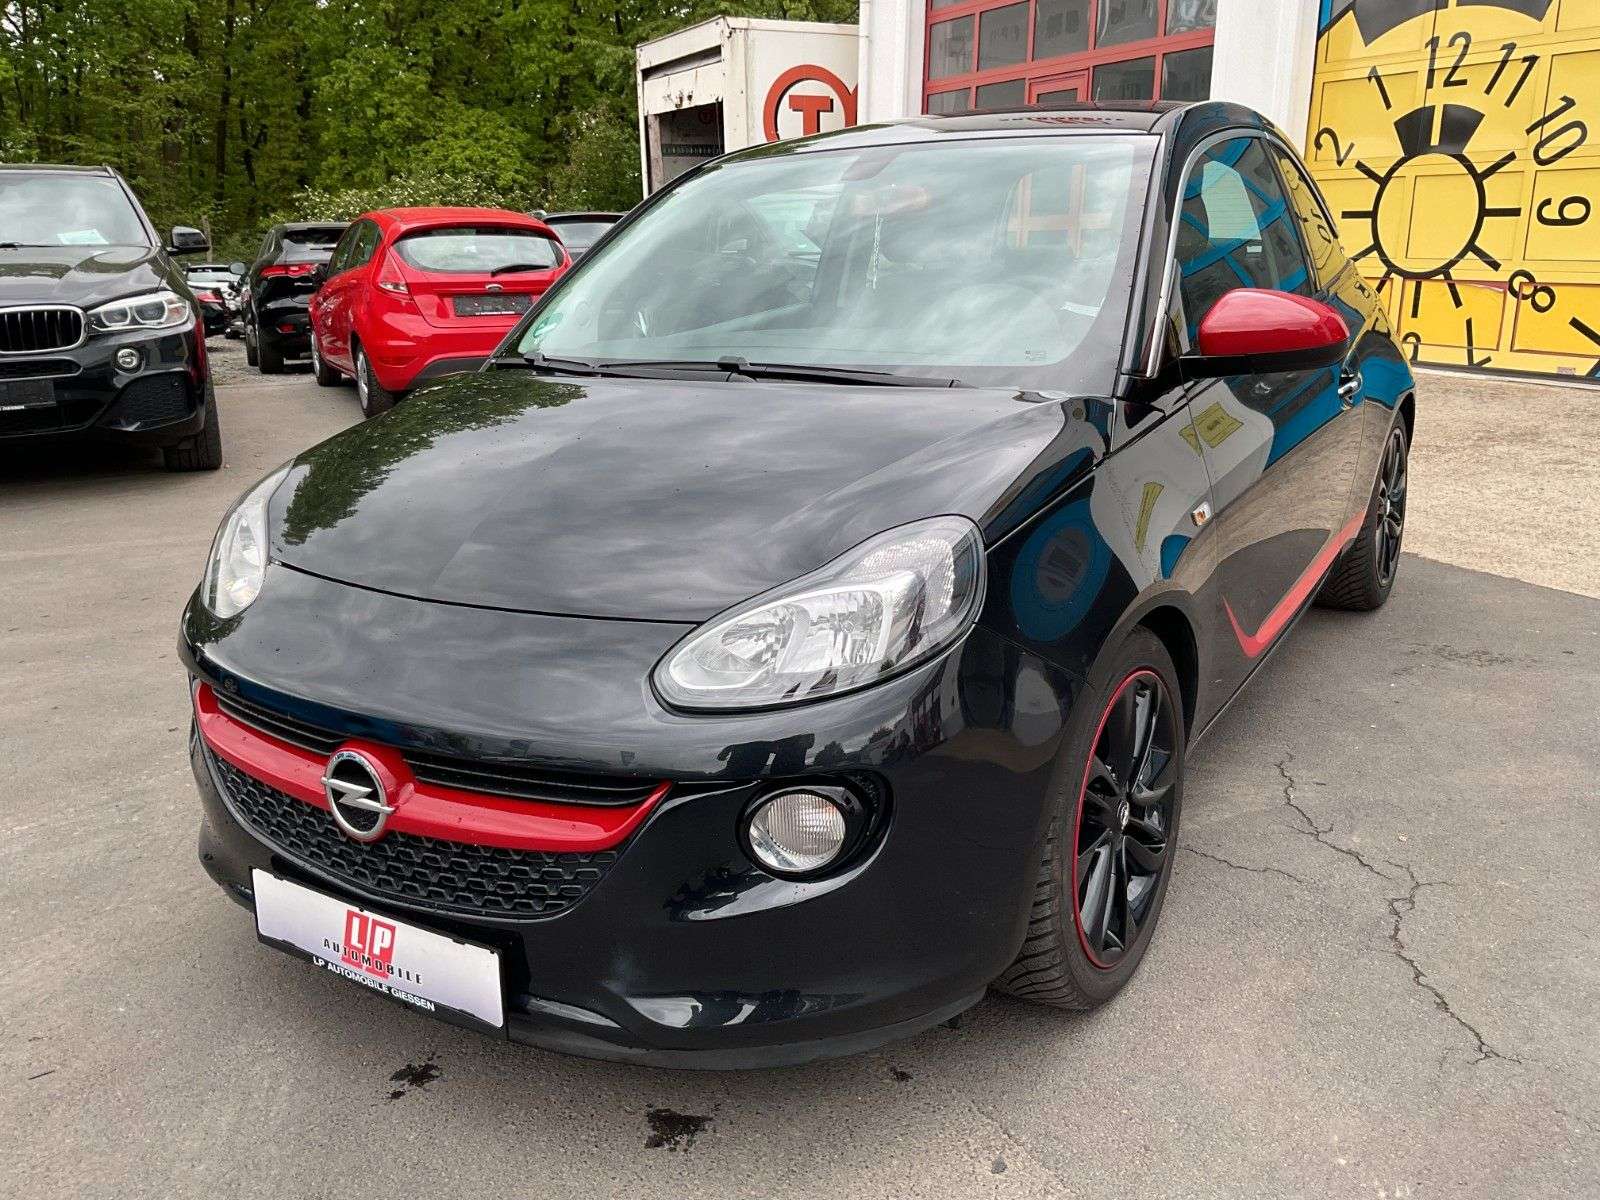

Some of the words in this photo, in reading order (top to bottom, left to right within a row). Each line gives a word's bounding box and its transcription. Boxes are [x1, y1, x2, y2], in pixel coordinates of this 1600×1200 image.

[1425, 31, 1472, 90] 12
[1484, 42, 1541, 108] 11
[1367, 65, 1393, 111] 1
[1314, 127, 1355, 167] 2
[1525, 95, 1588, 167] 10
[1507, 269, 1557, 314] 8
[351, 915, 392, 956] LP
[312, 955, 326, 967] LP
[327, 962, 390, 994] AUTOMOBILE
[391, 987, 436, 1012] GIESSEN
[323, 938, 423, 985] AUTOMOBILE
